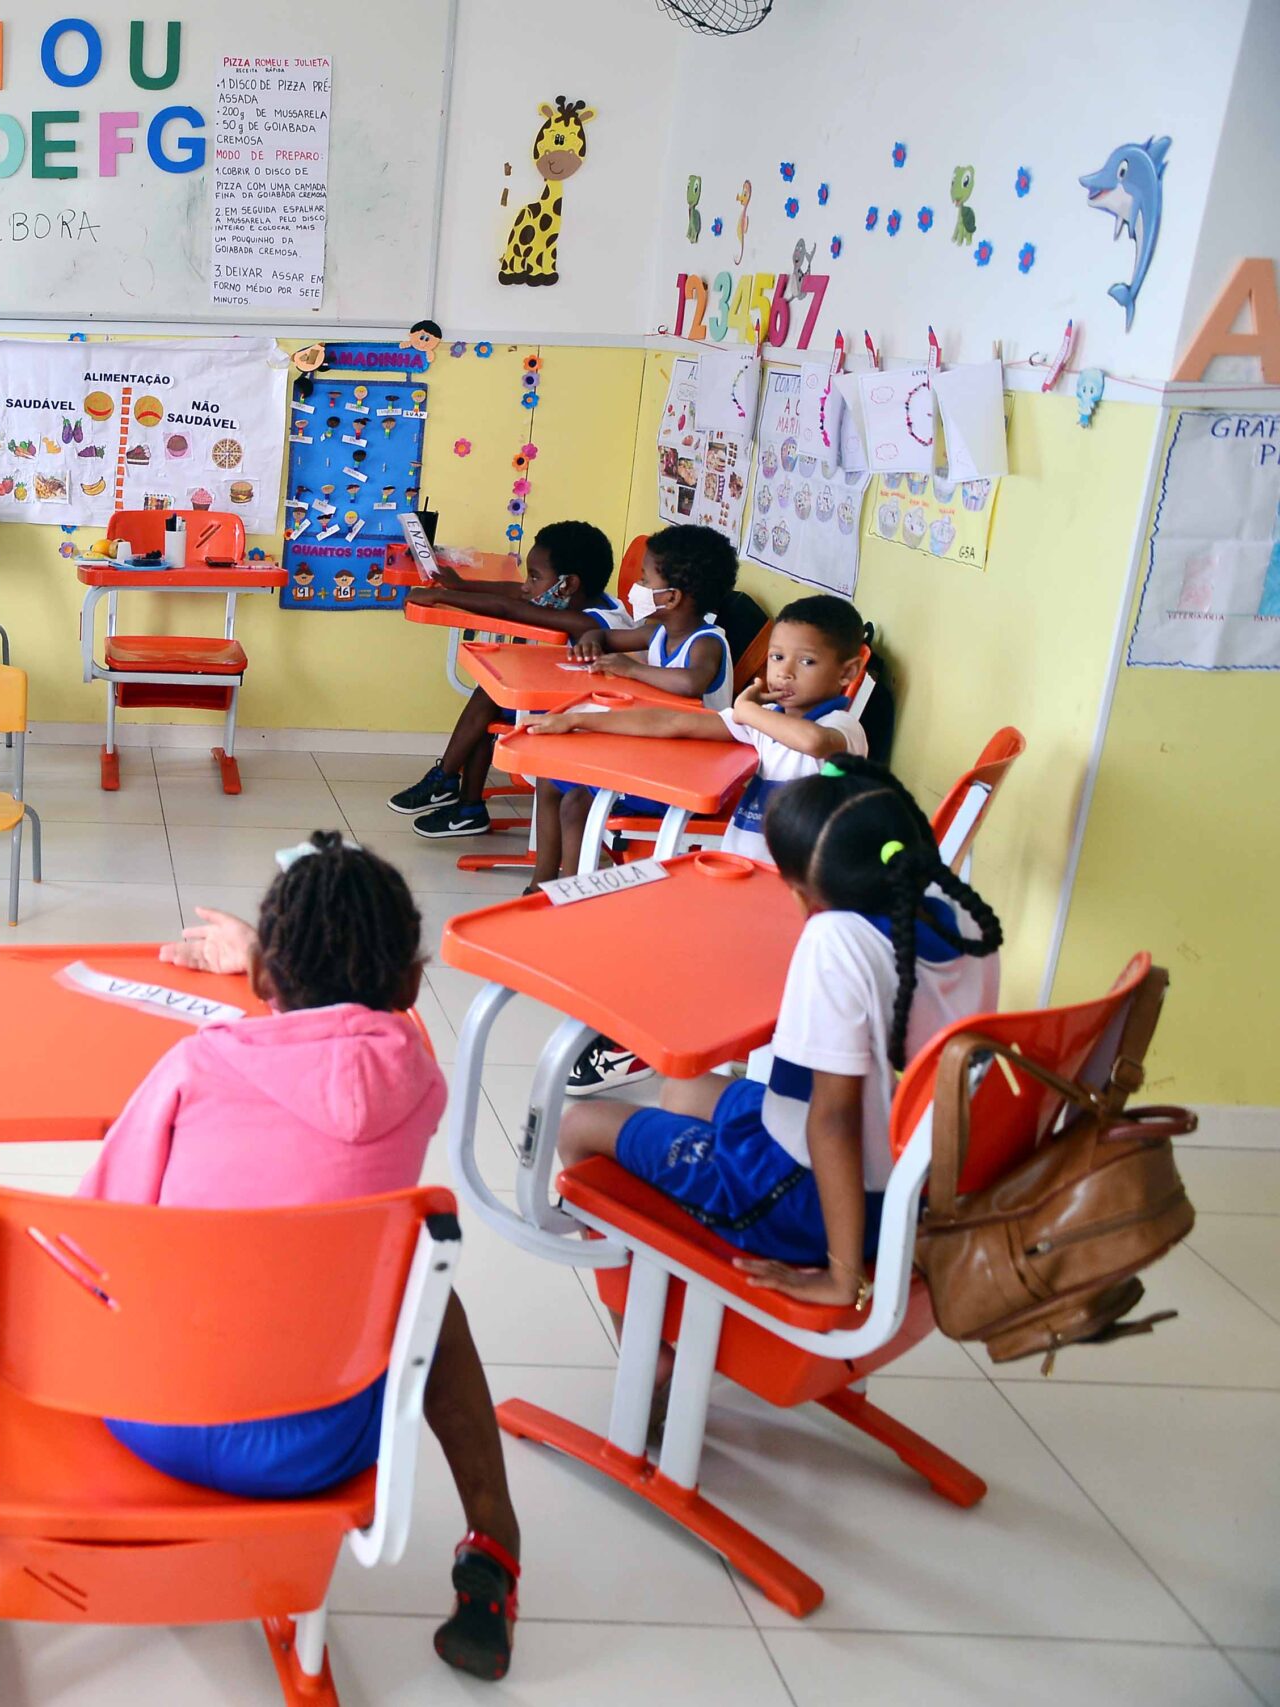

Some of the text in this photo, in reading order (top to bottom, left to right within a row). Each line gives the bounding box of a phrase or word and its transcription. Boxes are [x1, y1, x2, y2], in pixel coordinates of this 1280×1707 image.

[130, 21, 181, 90] U
[224, 57, 250, 67] PIZZA
[229, 79, 257, 89] DISCO
[260, 80, 271, 90] DE
[278, 80, 306, 91] PIZZA
[219, 93, 258, 104] ASSADA
[256, 109, 266, 117] DE
[275, 109, 327, 119] MUSSARELA
[249, 122, 258, 130] DE
[264, 122, 316, 132] GOIABADA
[217, 135, 263, 145] CREMOSA
[216, 150, 240, 160] MODO
[252, 151, 264, 160] DE
[255, 167, 260, 175] O
[217, 181, 242, 190] PIZZA
[247, 182, 266, 190] COM
[225, 208, 237, 216] EM
[283, 205, 324, 213] ESPALHAR
[232, 236, 274, 244] POUQUINHO
[215, 245, 253, 254] GOIABADA
[226, 266, 262, 277] DEIXAR
[272, 270, 304, 282] ASSAR
[311, 275, 324, 284] EM
[214, 281, 240, 292] FORNO
[246, 283, 272, 293] MÉDIO
[300, 288, 320, 297] SETE
[1171, 257, 1280, 384] A
[84, 373, 170, 386] ALIMENTAÇÃO
[6, 398, 76, 411] SAUDÁVEL
[192, 400, 220, 413] NÃO
[784, 398, 790, 414] A
[167, 413, 237, 429] SAUDÁVEL
[407, 521, 430, 558] ENZO
[292, 544, 352, 557] QUANTOS
[339, 586, 349, 596] 16
[109, 981, 221, 1016] MARIA
